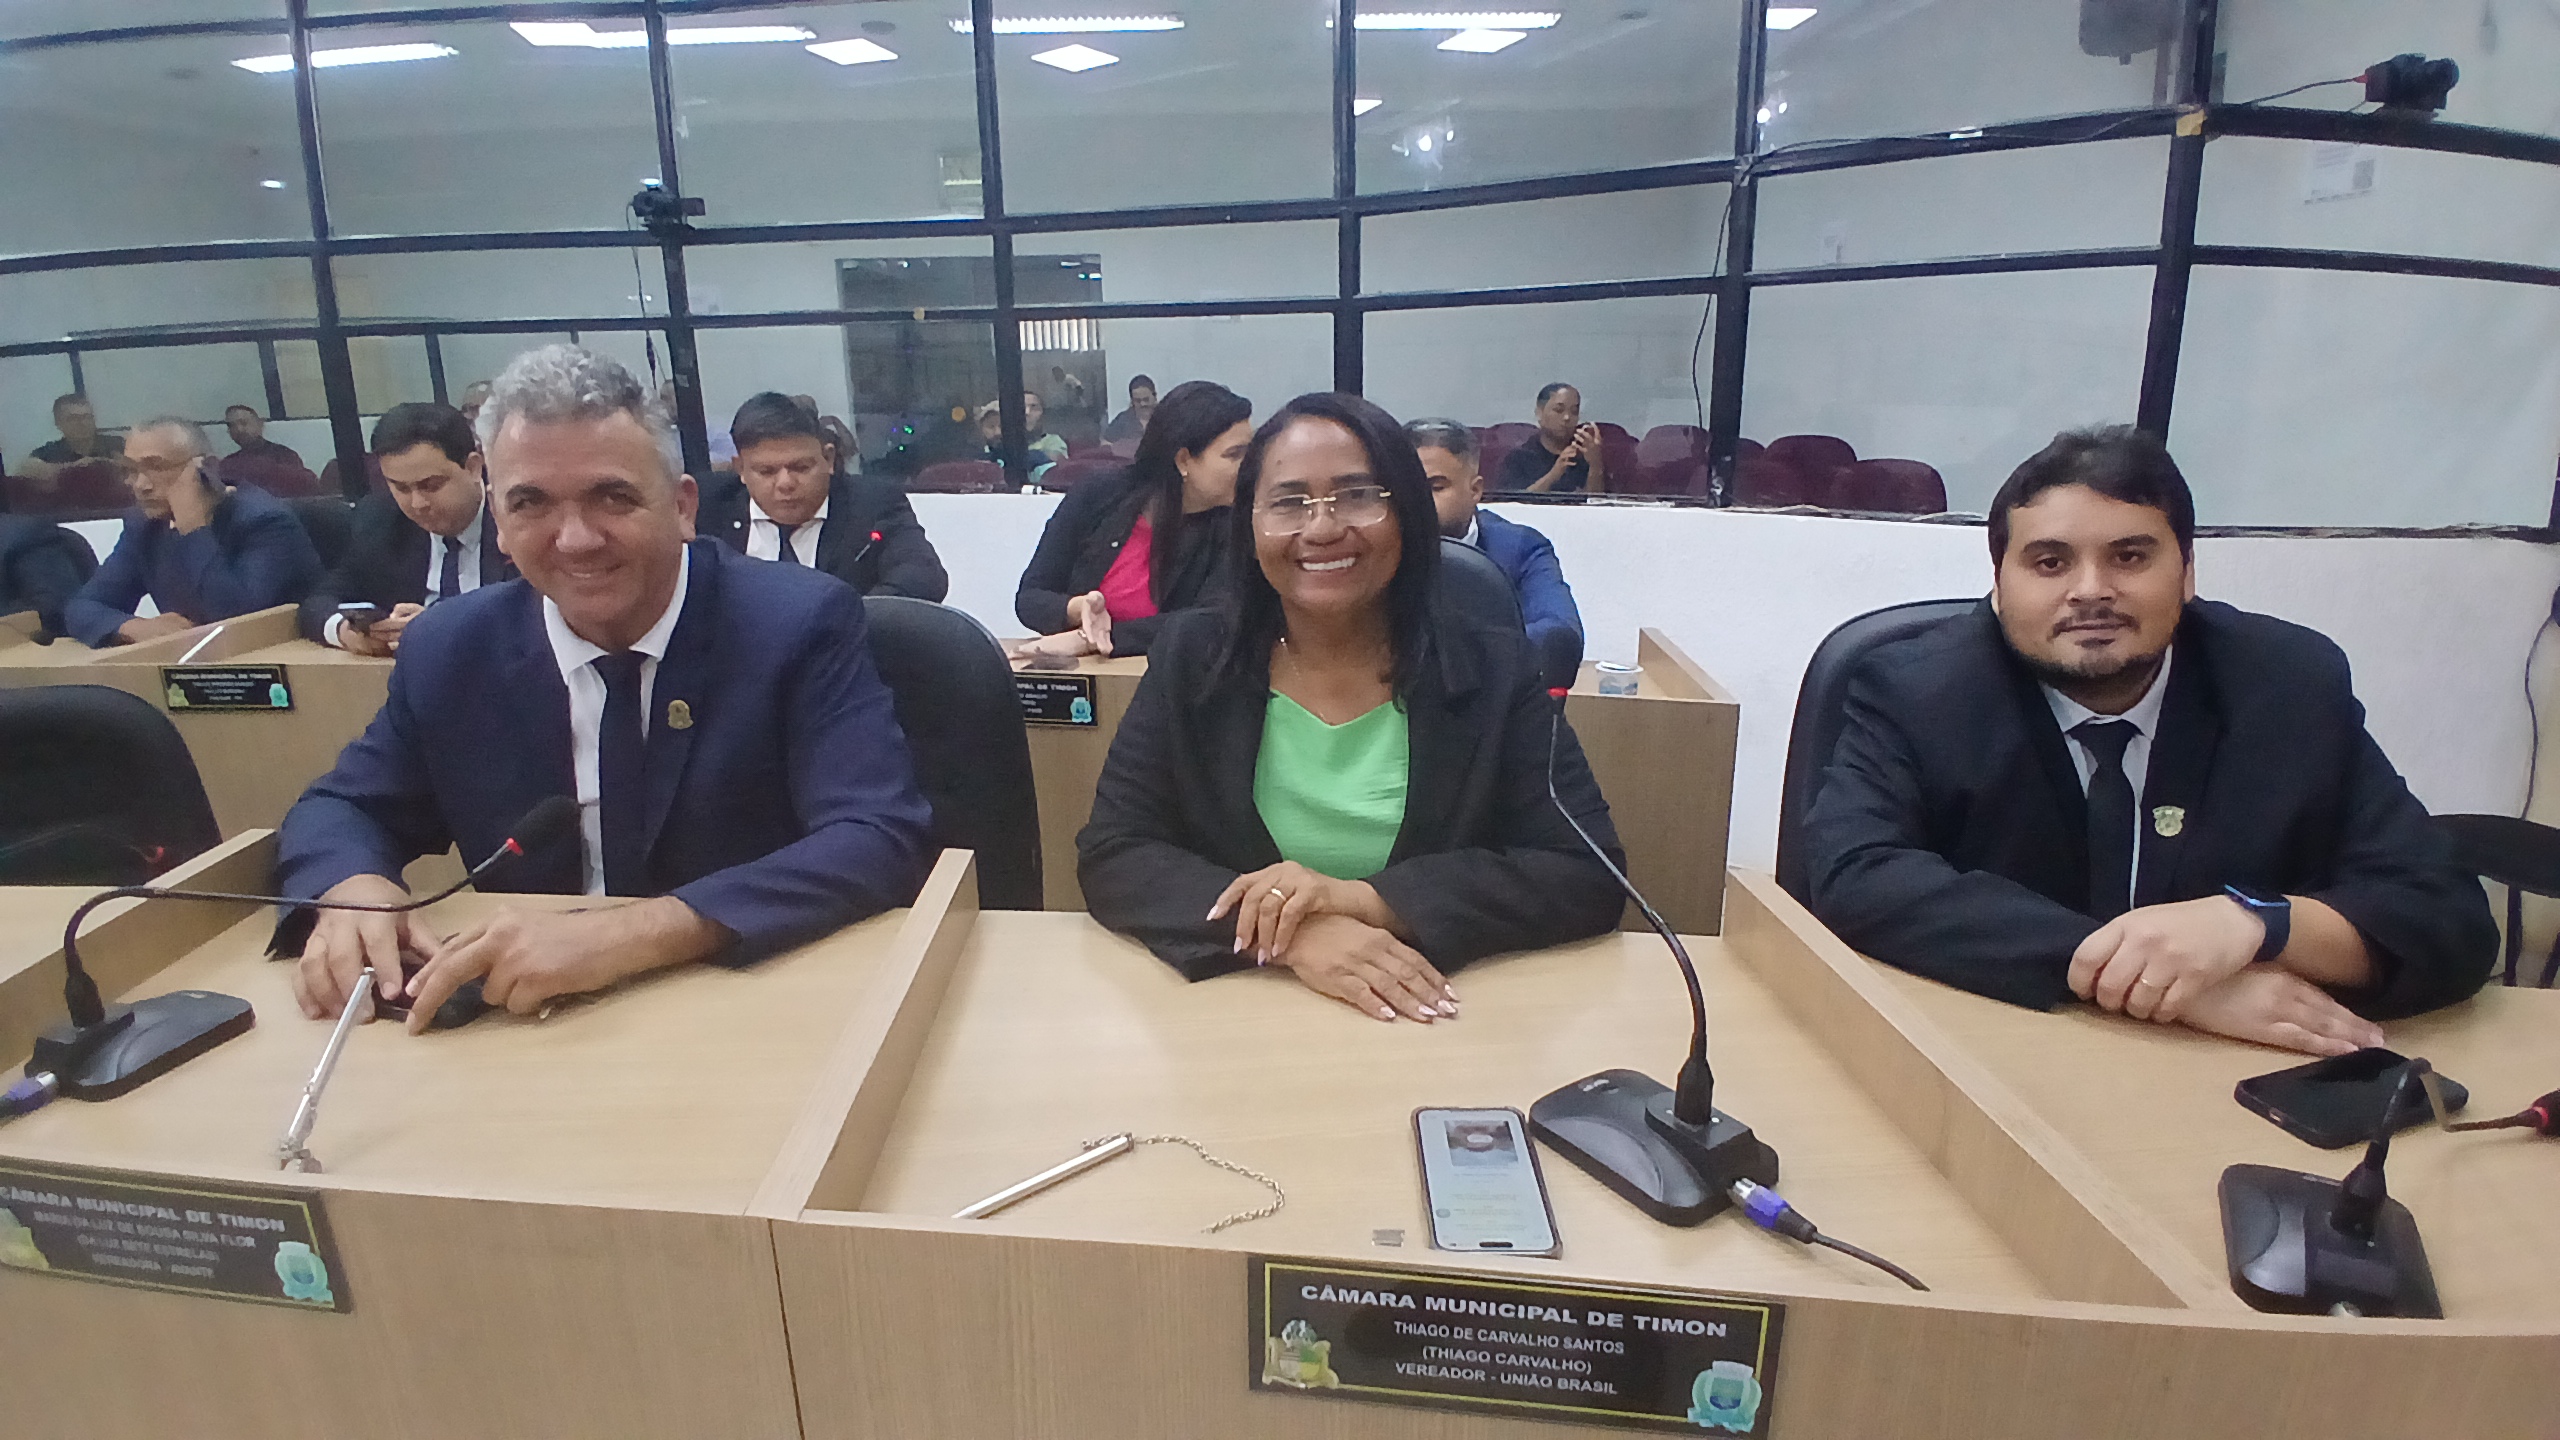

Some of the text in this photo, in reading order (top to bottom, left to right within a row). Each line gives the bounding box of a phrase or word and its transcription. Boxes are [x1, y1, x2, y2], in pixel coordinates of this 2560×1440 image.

[76, 1197, 181, 1220] MUNICIPAL
[185, 1209, 212, 1225] DE
[216, 1212, 285, 1233] TIMON
[1302, 1284, 1727, 1337] CÂMARA MUNICIPAL DE TIMON
[1393, 1321, 1625, 1355] THIAGO DE CARVALHO SANTOS
[1422, 1345, 1592, 1375] (THIAGO CARVALHO)
[1395, 1362, 1486, 1382] VEREADOR
[1500, 1371, 1553, 1389] UNIÃO
[1557, 1377, 1618, 1396] BRASIL
